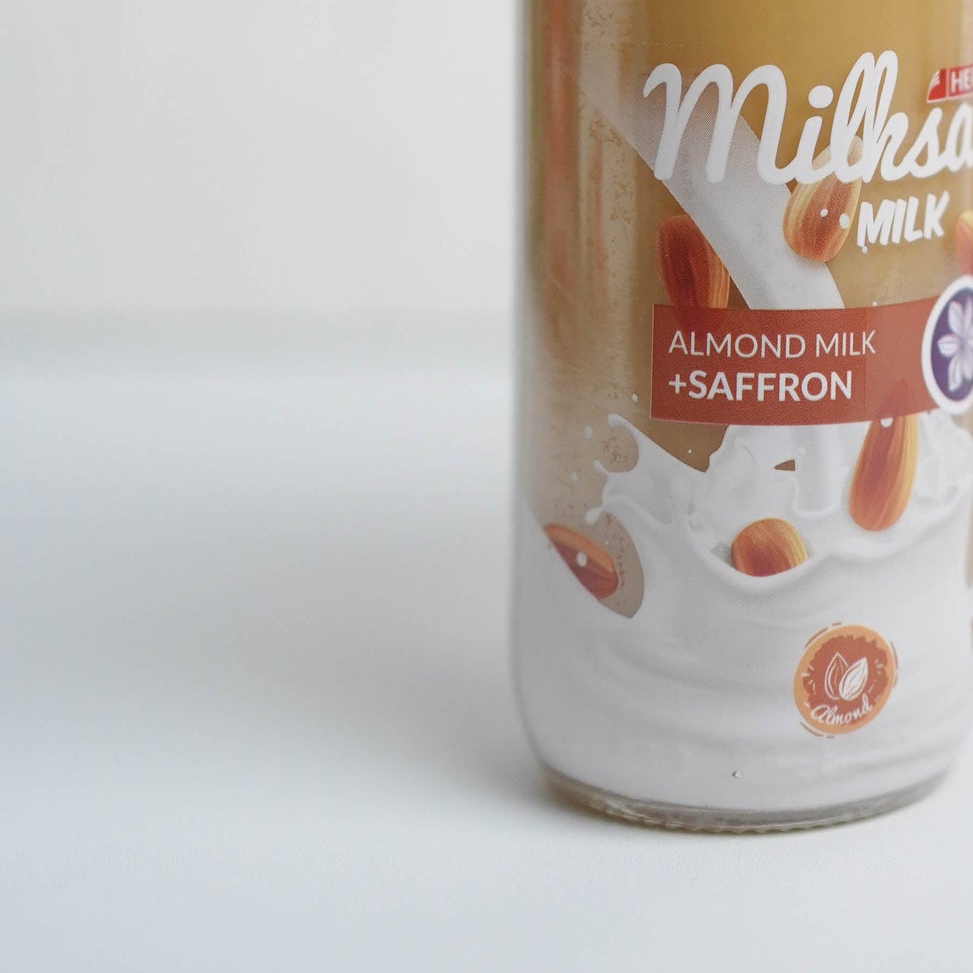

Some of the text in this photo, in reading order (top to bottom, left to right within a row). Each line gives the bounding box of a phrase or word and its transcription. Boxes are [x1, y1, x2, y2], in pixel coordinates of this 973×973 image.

[857, 191, 950, 247] MILK
[668, 330, 876, 358] ALMOND MILK
[668, 370, 852, 402] +SAFFRON
[810, 693, 873, 725] Almond
